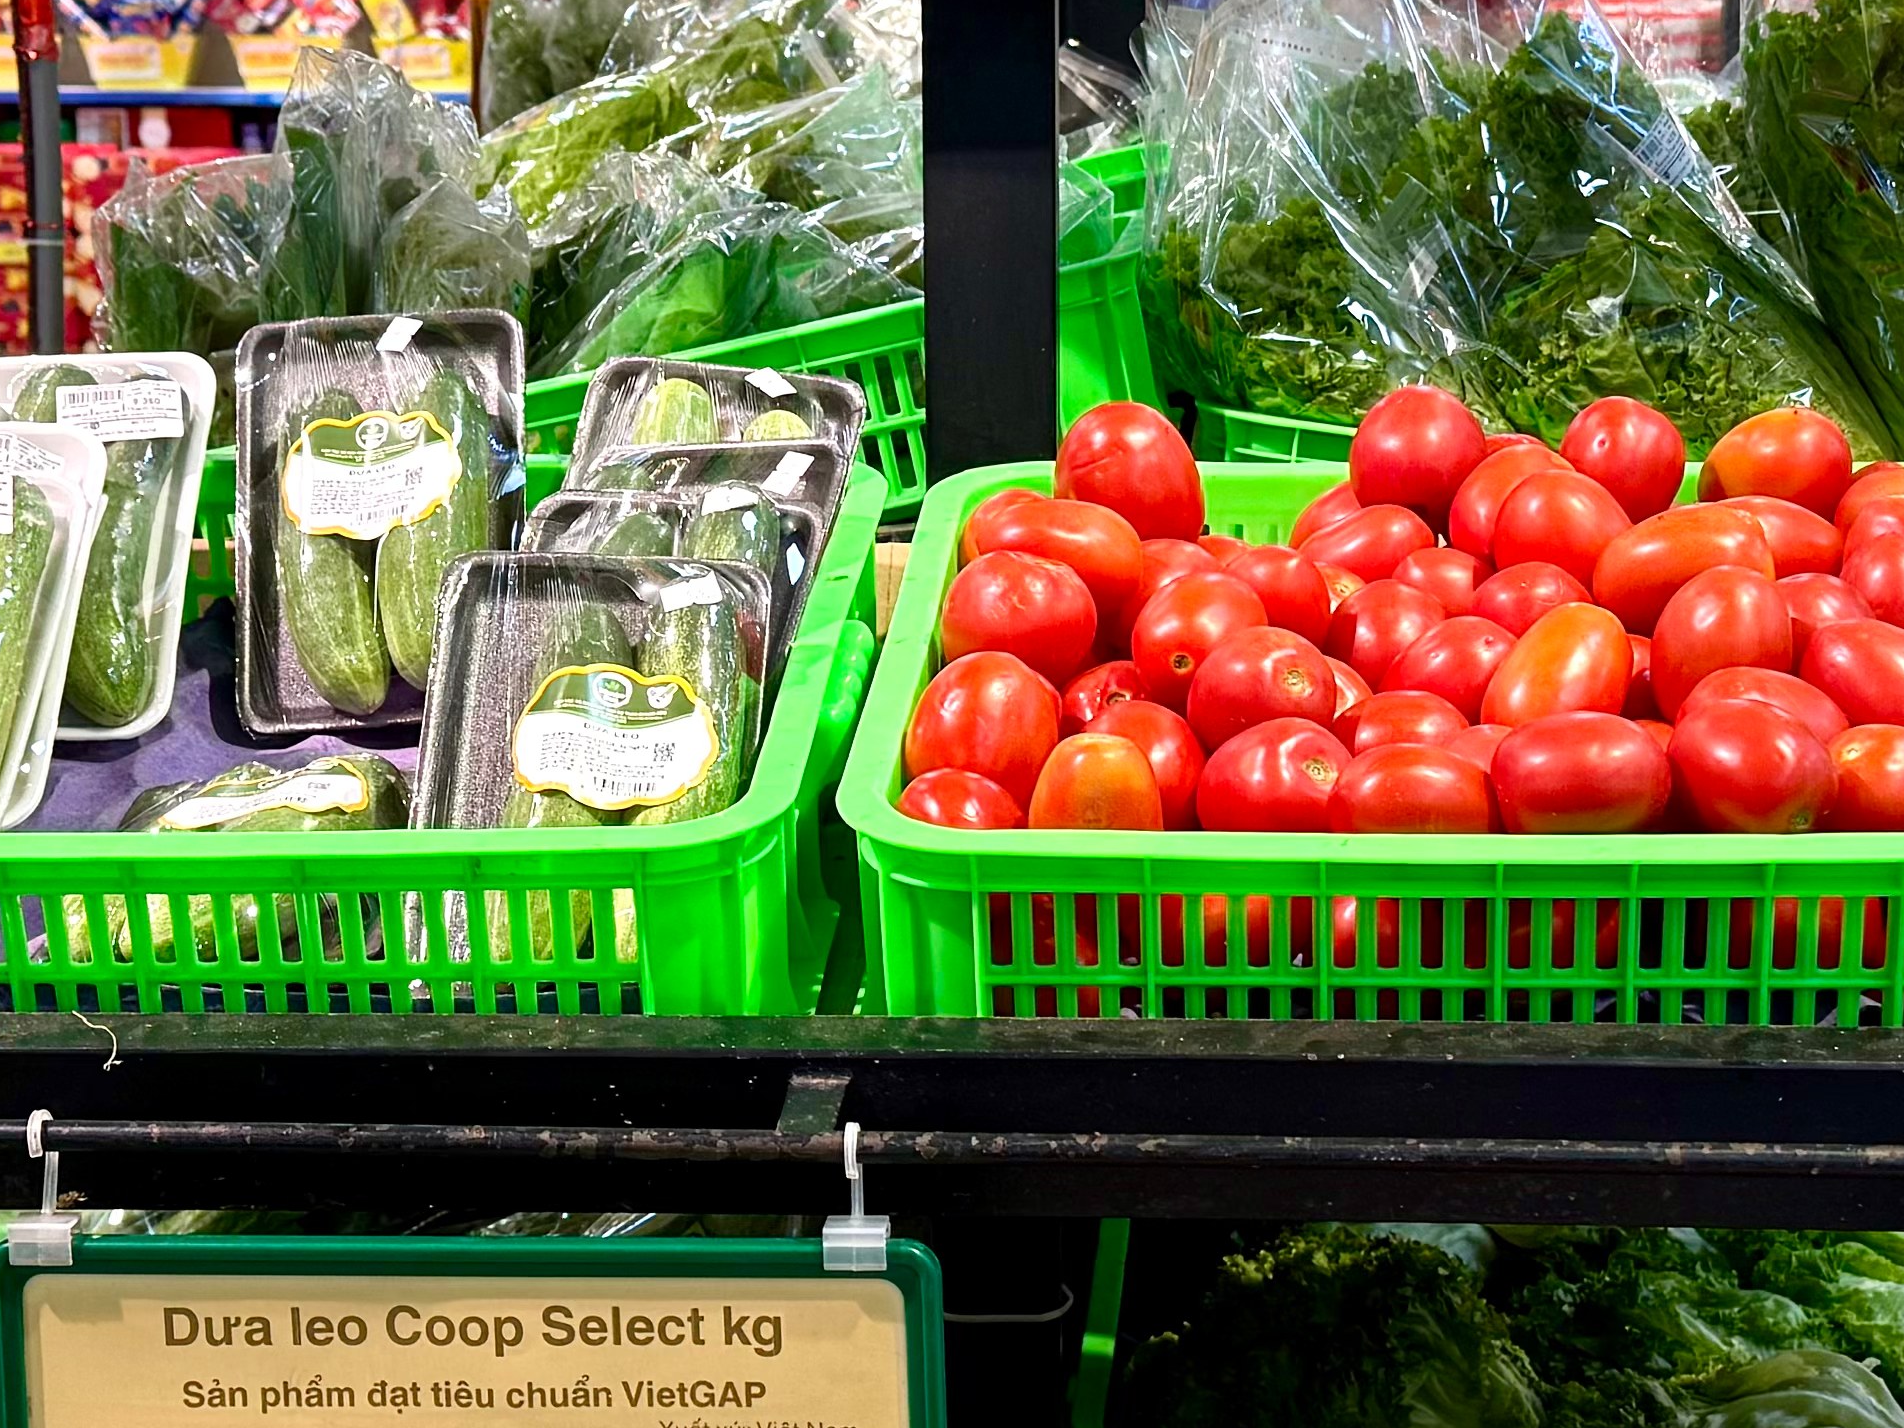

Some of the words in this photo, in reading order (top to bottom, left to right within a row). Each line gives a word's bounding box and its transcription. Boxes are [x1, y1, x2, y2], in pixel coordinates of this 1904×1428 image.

[163, 1306, 274, 1347] Dưa
[292, 1306, 369, 1347] leo
[384, 1305, 526, 1356] Coop
[541, 1305, 707, 1347] Select
[723, 1305, 784, 1356] kg
[181, 1377, 253, 1408] Sản
[261, 1373, 357, 1414] phẩm
[366, 1379, 422, 1413] đạt
[430, 1379, 496, 1409] tiêu
[506, 1373, 614, 1409] chuẩn
[622, 1379, 768, 1408] VietGAP
